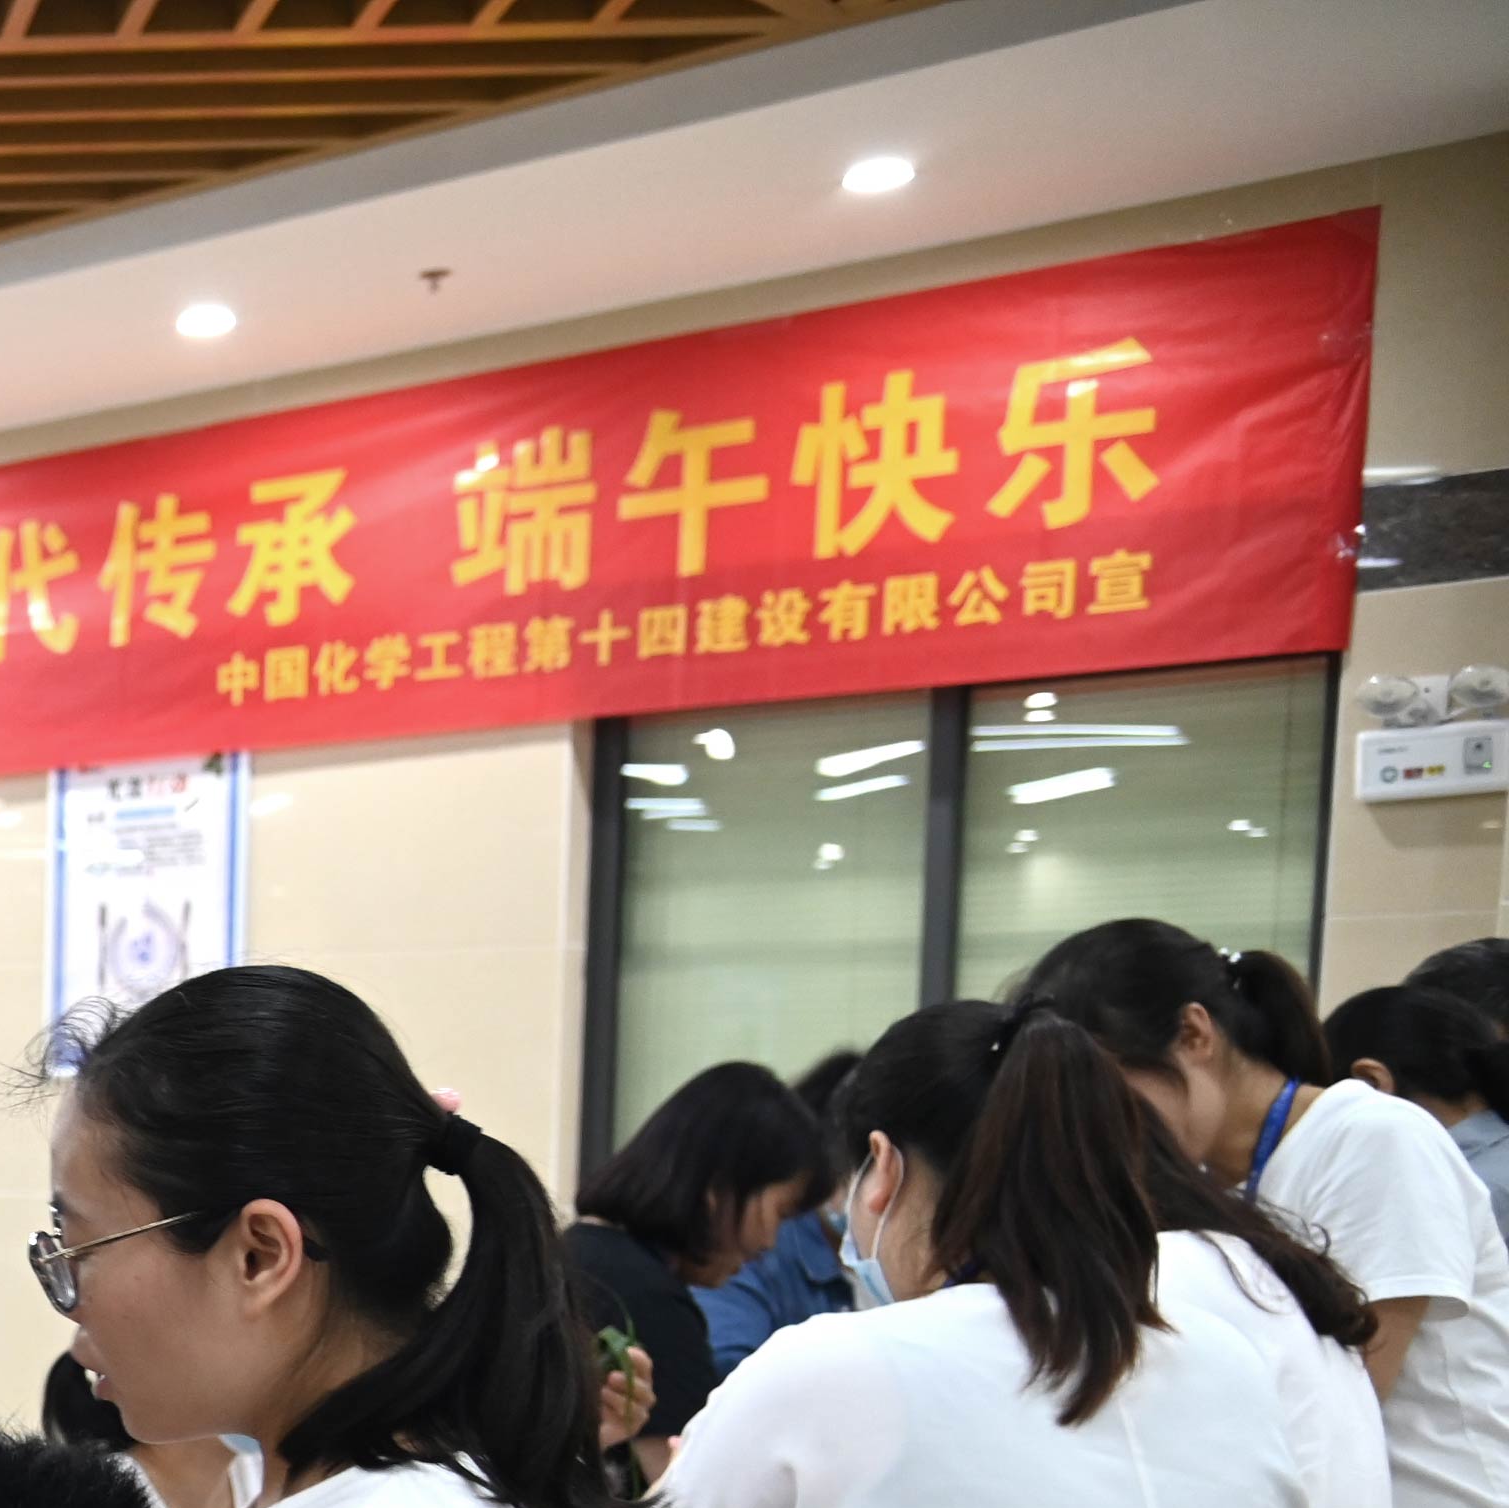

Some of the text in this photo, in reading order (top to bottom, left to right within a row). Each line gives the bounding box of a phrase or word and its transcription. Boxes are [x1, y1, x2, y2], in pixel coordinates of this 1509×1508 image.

[451, 336, 1161, 597] 端午快乐
[216, 549, 1153, 705] 中国化学工程第十四建设有限公司宣
